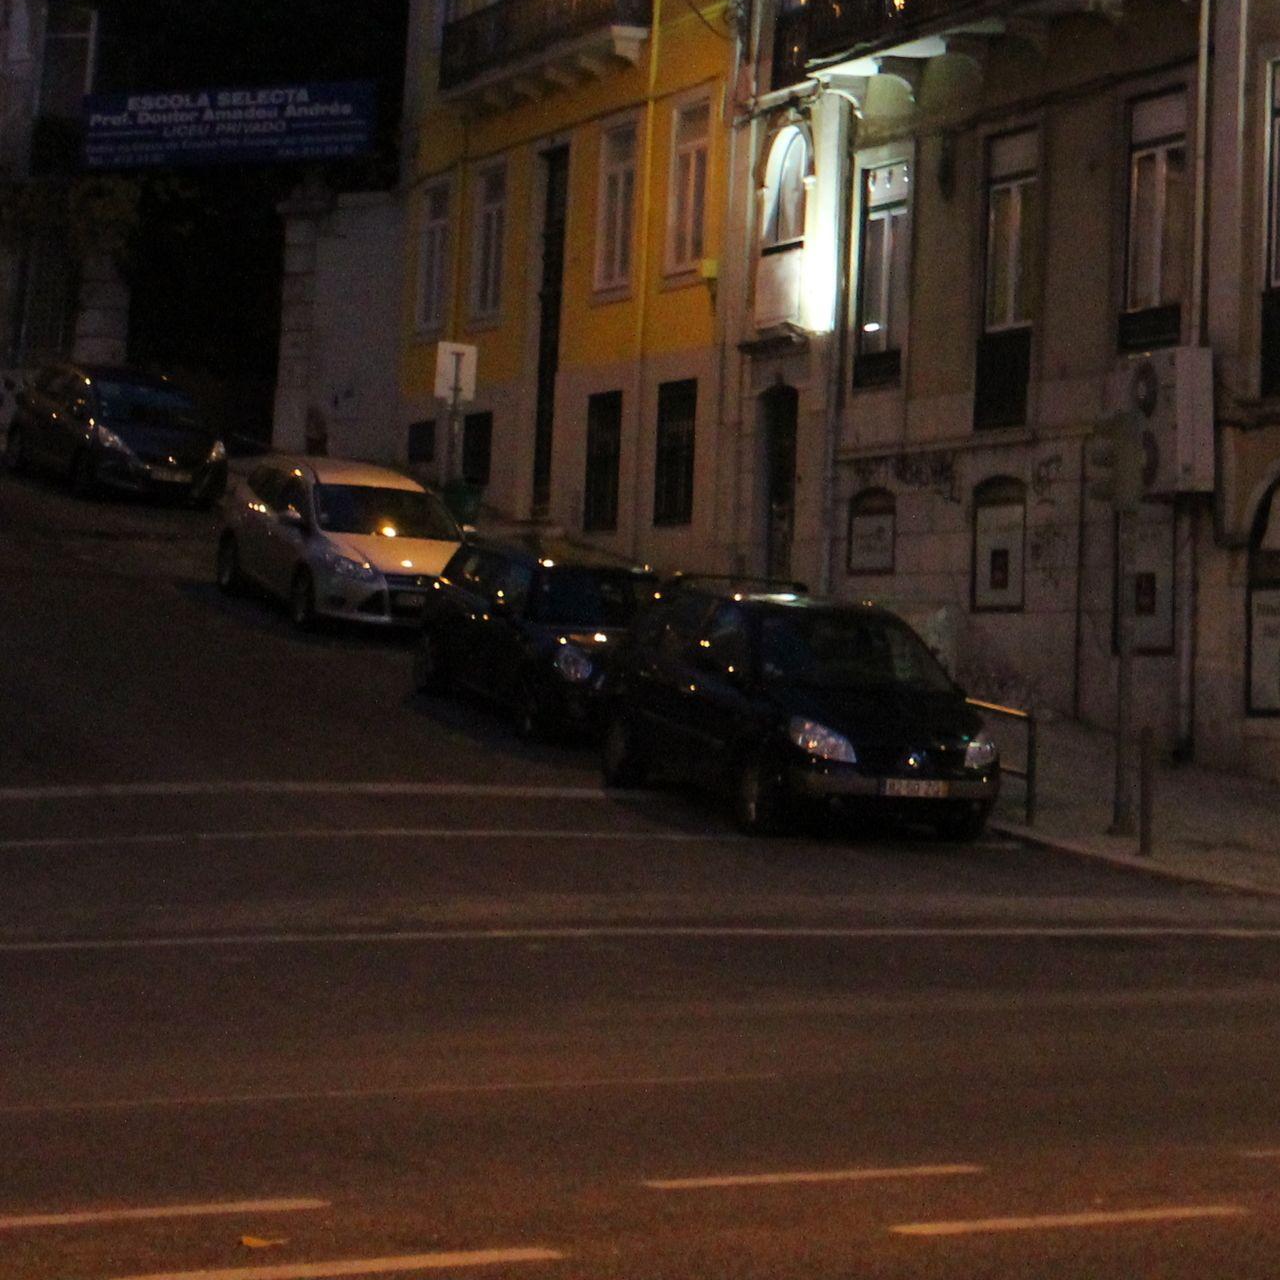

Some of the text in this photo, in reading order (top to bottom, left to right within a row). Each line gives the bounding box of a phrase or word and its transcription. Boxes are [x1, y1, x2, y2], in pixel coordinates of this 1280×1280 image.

[127, 87, 309, 112] ESCOLA SELECTA
[89, 111, 134, 127] Prof.
[136, 110, 199, 125] Doutor
[202, 105, 278, 122] Amadeu
[162, 120, 286, 138] LICEU PRIVADO
